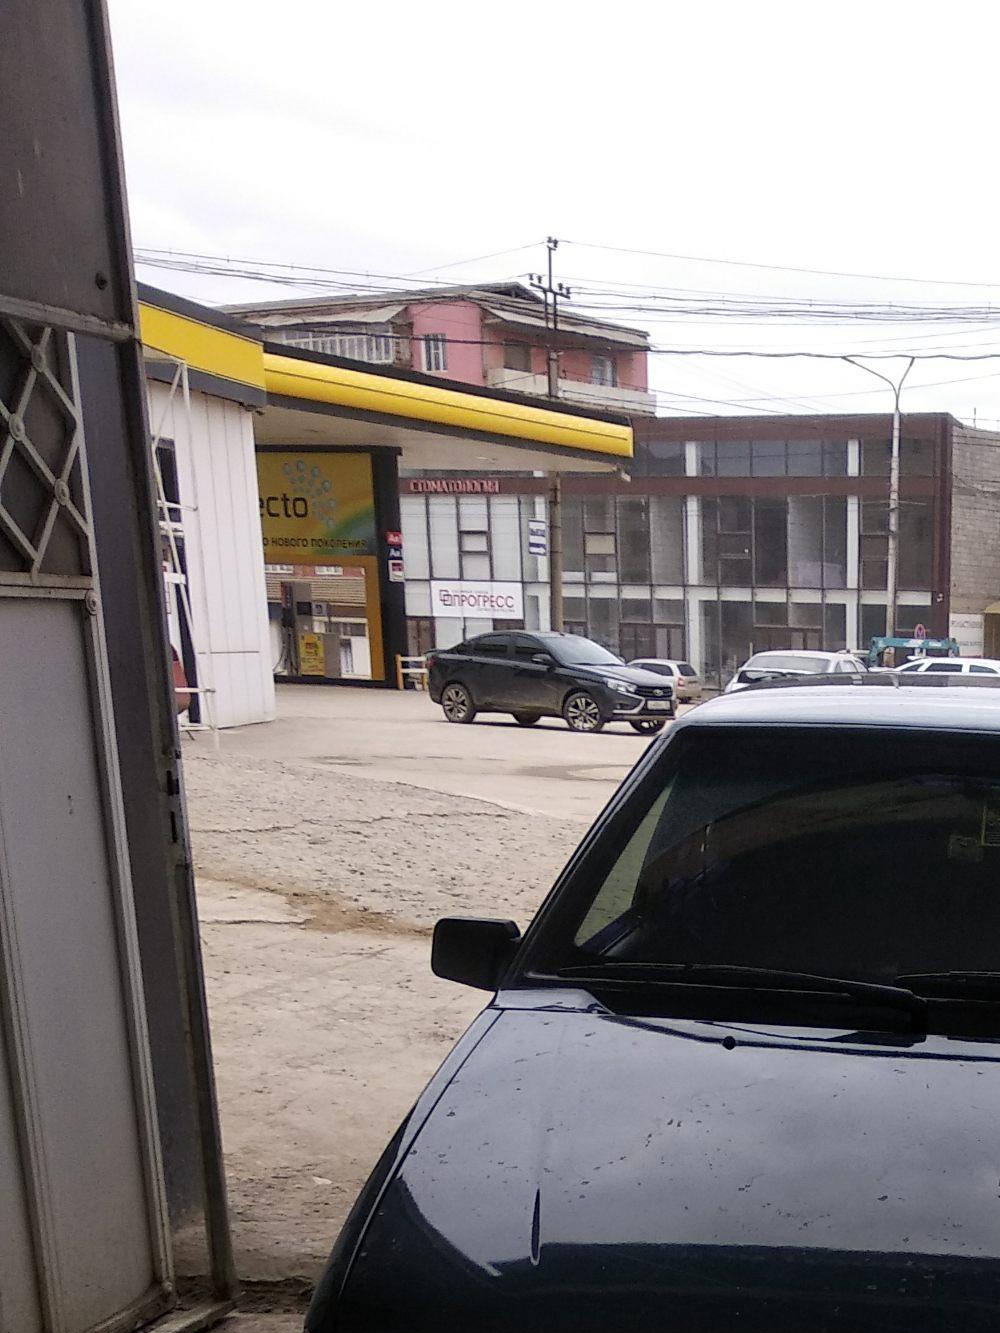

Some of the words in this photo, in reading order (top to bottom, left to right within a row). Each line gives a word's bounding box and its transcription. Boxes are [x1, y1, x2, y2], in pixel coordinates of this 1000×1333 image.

[271, 537, 308, 548] НОВОГО
[311, 538, 367, 549] ПОКОЛЕНИЯ
[452, 594, 515, 609] ПРОГРЕСС
